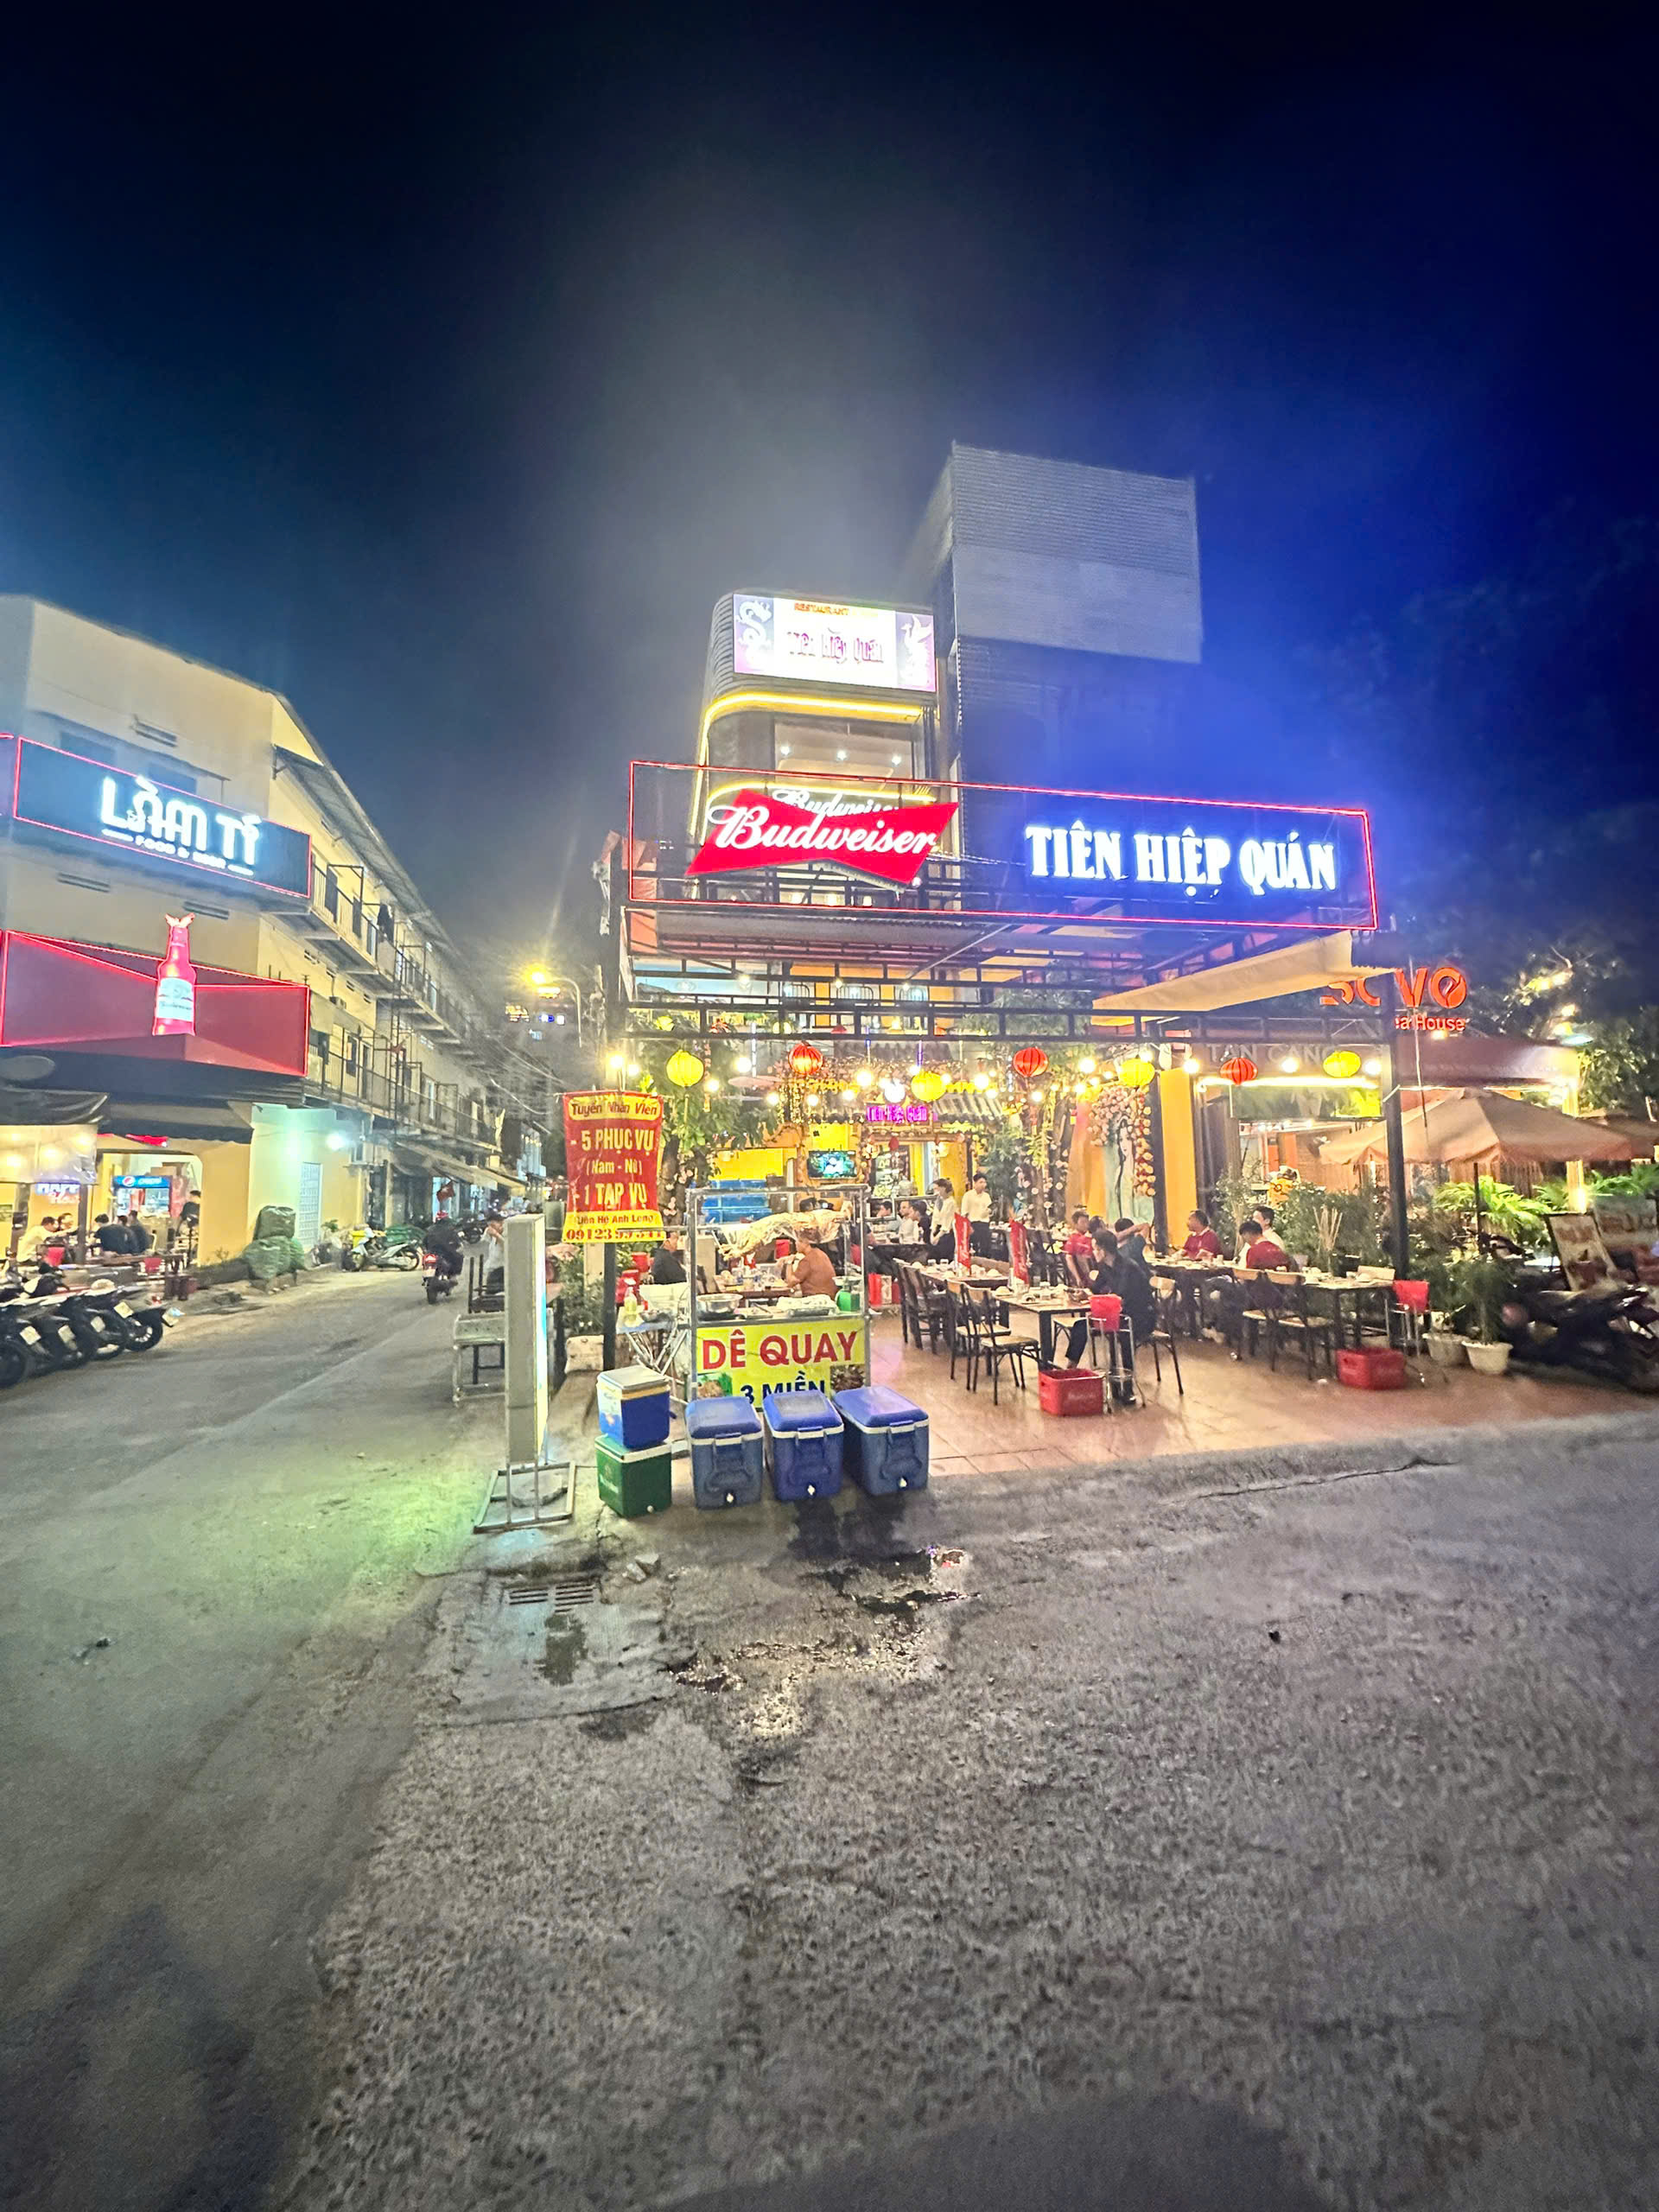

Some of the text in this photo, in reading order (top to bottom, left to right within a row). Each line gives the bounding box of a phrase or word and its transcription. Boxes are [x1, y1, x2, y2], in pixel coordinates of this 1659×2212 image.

[707, 804, 938, 855] Budweiser
[1025, 819, 1336, 898] TIÊN HIỆP QUÁN
[581, 1129, 592, 1152] 5
[595, 1128, 633, 1154] PHỤC
[634, 1129, 655, 1156] VỤ
[594, 1182, 625, 1210] TẠP
[702, 1328, 858, 1370] DÊ QUAY
